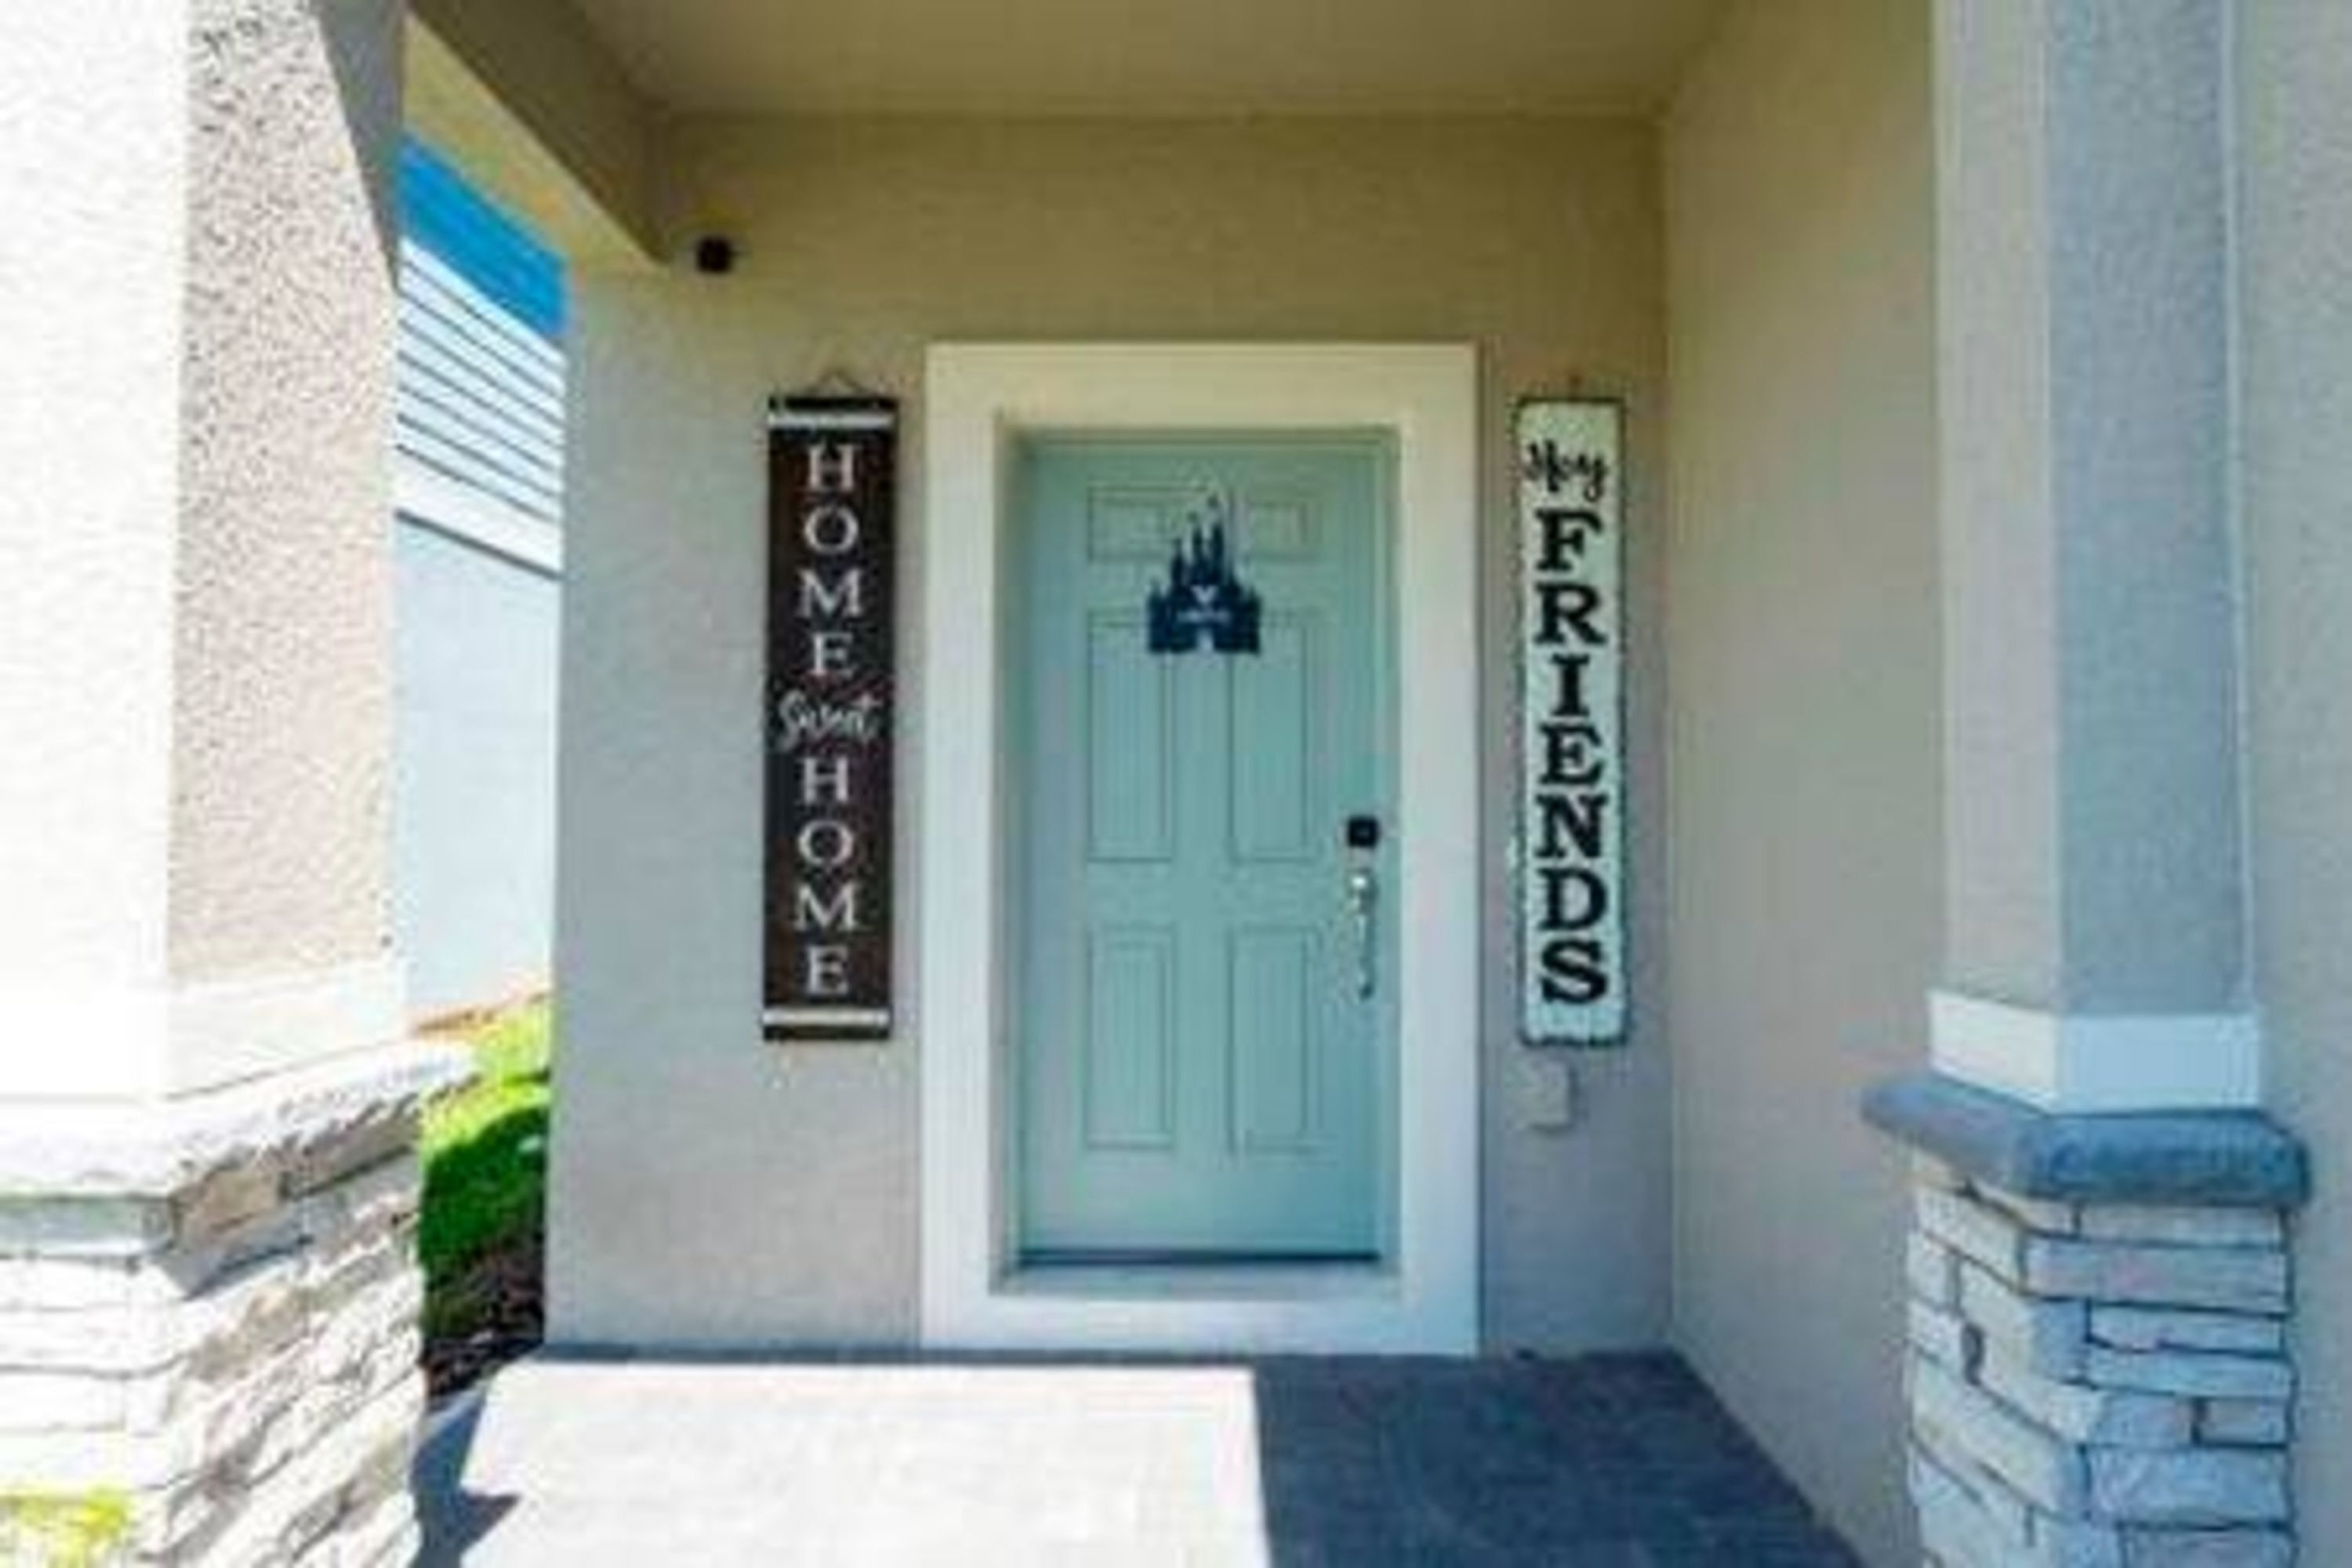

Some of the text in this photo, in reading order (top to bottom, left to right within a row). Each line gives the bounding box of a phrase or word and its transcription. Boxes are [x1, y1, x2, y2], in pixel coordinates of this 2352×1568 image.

[797, 441, 865, 677] HOME
[1532, 506, 1609, 1005] FRIENDS
[794, 756, 860, 996] HOME
